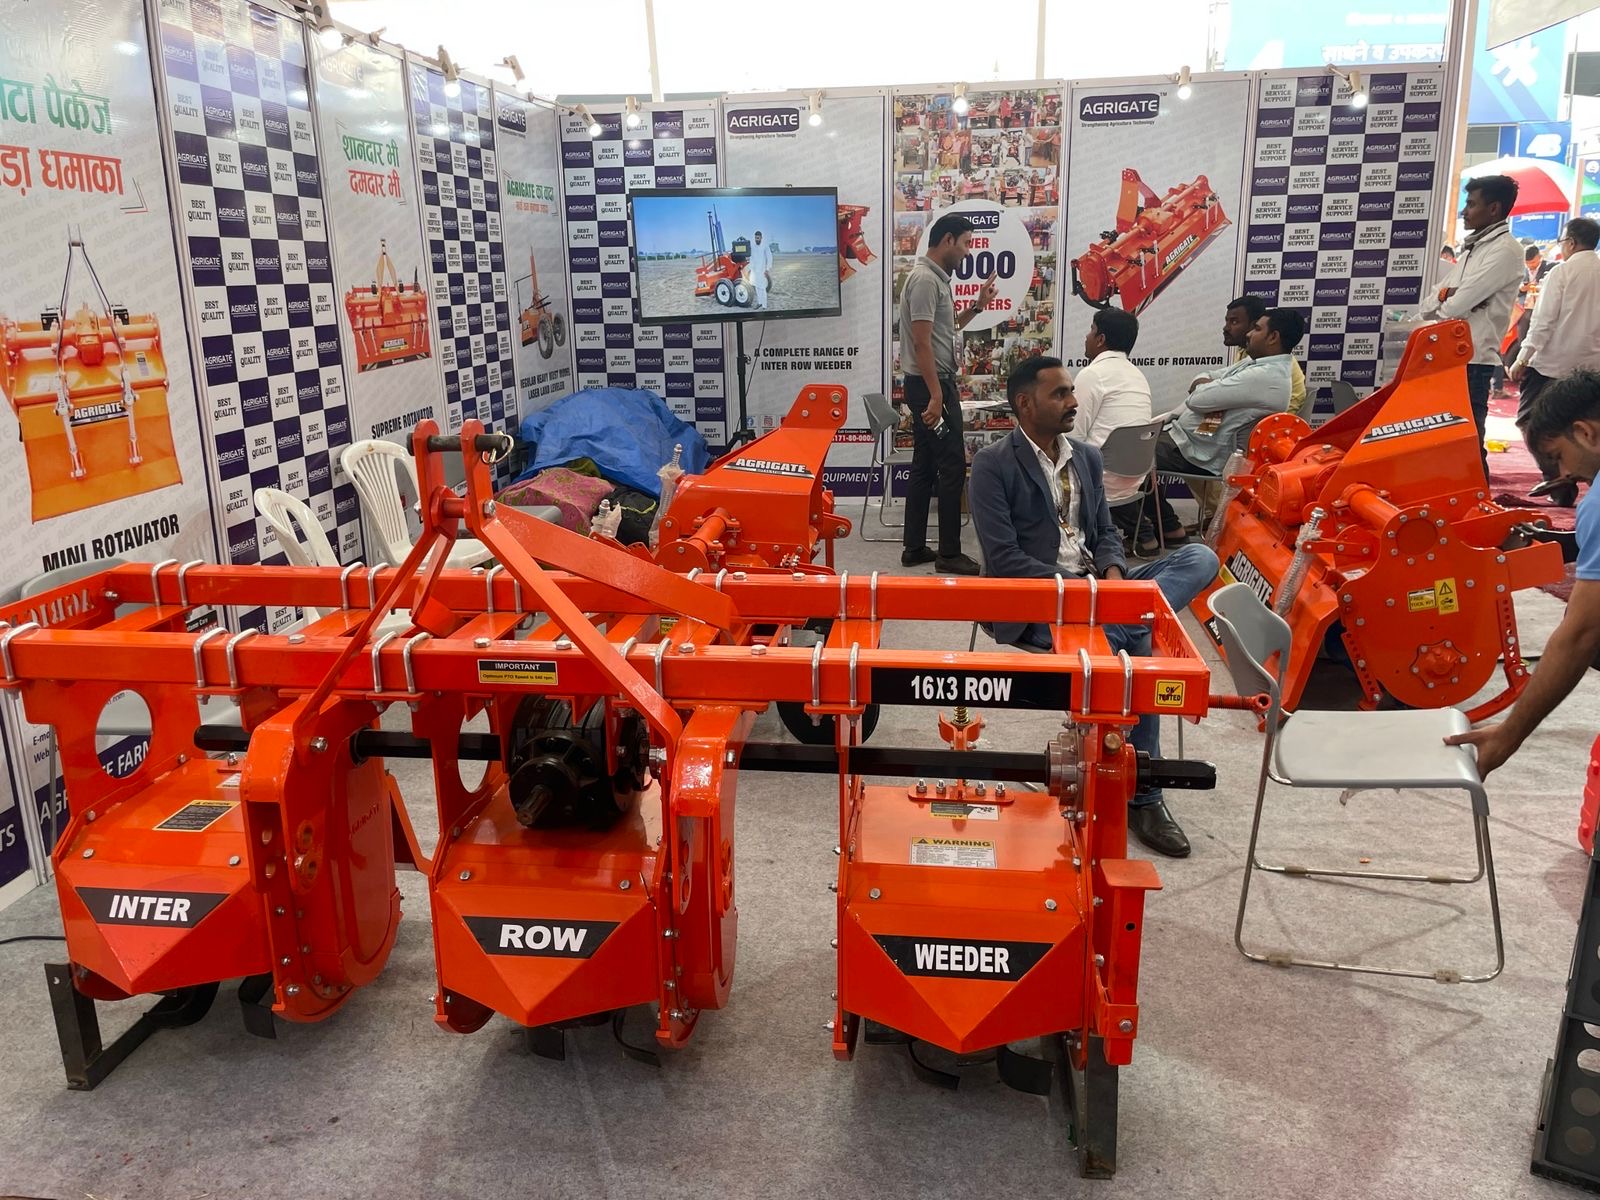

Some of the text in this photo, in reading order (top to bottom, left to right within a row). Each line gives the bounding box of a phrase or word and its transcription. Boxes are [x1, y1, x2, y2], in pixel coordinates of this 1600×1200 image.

[43, 73, 112, 135] पैकेज
[1082, 100, 1158, 115] AGRIGATE
[204, 105, 234, 122] AGRIGATE
[294, 121, 307, 132] BEST
[654, 121, 681, 129] AGRIGATE
[730, 113, 798, 128] AGRIGATE
[264, 120, 289, 134] AGRIGATE
[294, 129, 311, 141] QUALITY
[343, 135, 399, 167] शानदार भी
[176, 153, 209, 167] AGRIGATE
[218, 153, 232, 163] BEST
[0, 145, 124, 196] ड़ा धमाका
[215, 163, 237, 175] QUALITY
[242, 162, 268, 176] AGRIGATE
[276, 162, 288, 173] BEST
[274, 171, 293, 182] QUALITY
[296, 170, 319, 183] AGRIGATE
[348, 169, 401, 198] दमदार भी
[507, 180, 535, 198] AGRIGATE
[191, 200, 206, 209] BEST
[254, 205, 267, 216] BEST
[187, 210, 212, 221] QUALITY
[218, 206, 246, 220] AGRIGATE
[252, 216, 272, 225] QUALITY
[969, 237, 989, 249] VER
[1165, 234, 1194, 264] AGRIGATE
[190, 256, 221, 267] AGRIGATE
[230, 252, 245, 261] BEST
[254, 256, 280, 268] AGRIGATE
[228, 262, 250, 272] QUALITY
[204, 301, 219, 309] BEST
[266, 297, 278, 306] BEST
[230, 302, 258, 314] AGRIGATE
[264, 307, 283, 318] QUALITY
[201, 311, 225, 322] QUALITY
[243, 346, 256, 355] BEST
[754, 346, 860, 357] A COMPLETE RANGE OF
[204, 354, 233, 366] AGRIGATE
[240, 355, 261, 367] QUALITY
[761, 360, 852, 370] INTER ROW WEEDER
[1067, 359, 1074, 367] A
[1158, 357, 1170, 366] OF
[1173, 356, 1224, 366] ROTAVATOR
[242, 395, 269, 407] AGRIGATE
[73, 402, 122, 420] AGRIGATE
[371, 405, 434, 440] SUPREME ROTAVATOR
[1371, 412, 1453, 437] AGRIGATE
[254, 436, 268, 447] BEST
[251, 444, 272, 459] QUALITY
[735, 458, 807, 473] AGRIGATE
[229, 490, 244, 500] BEST
[226, 497, 249, 514] QUALITY
[42, 513, 180, 573] MINI ROTAVATOR
[495, 663, 540, 671] IMPORTANT
[911, 675, 1012, 702] 16X3 ROW
[933, 839, 991, 848] WARNING
[108, 894, 191, 922] INTER
[499, 924, 588, 952] ROW
[915, 943, 1010, 973] WEEDER
